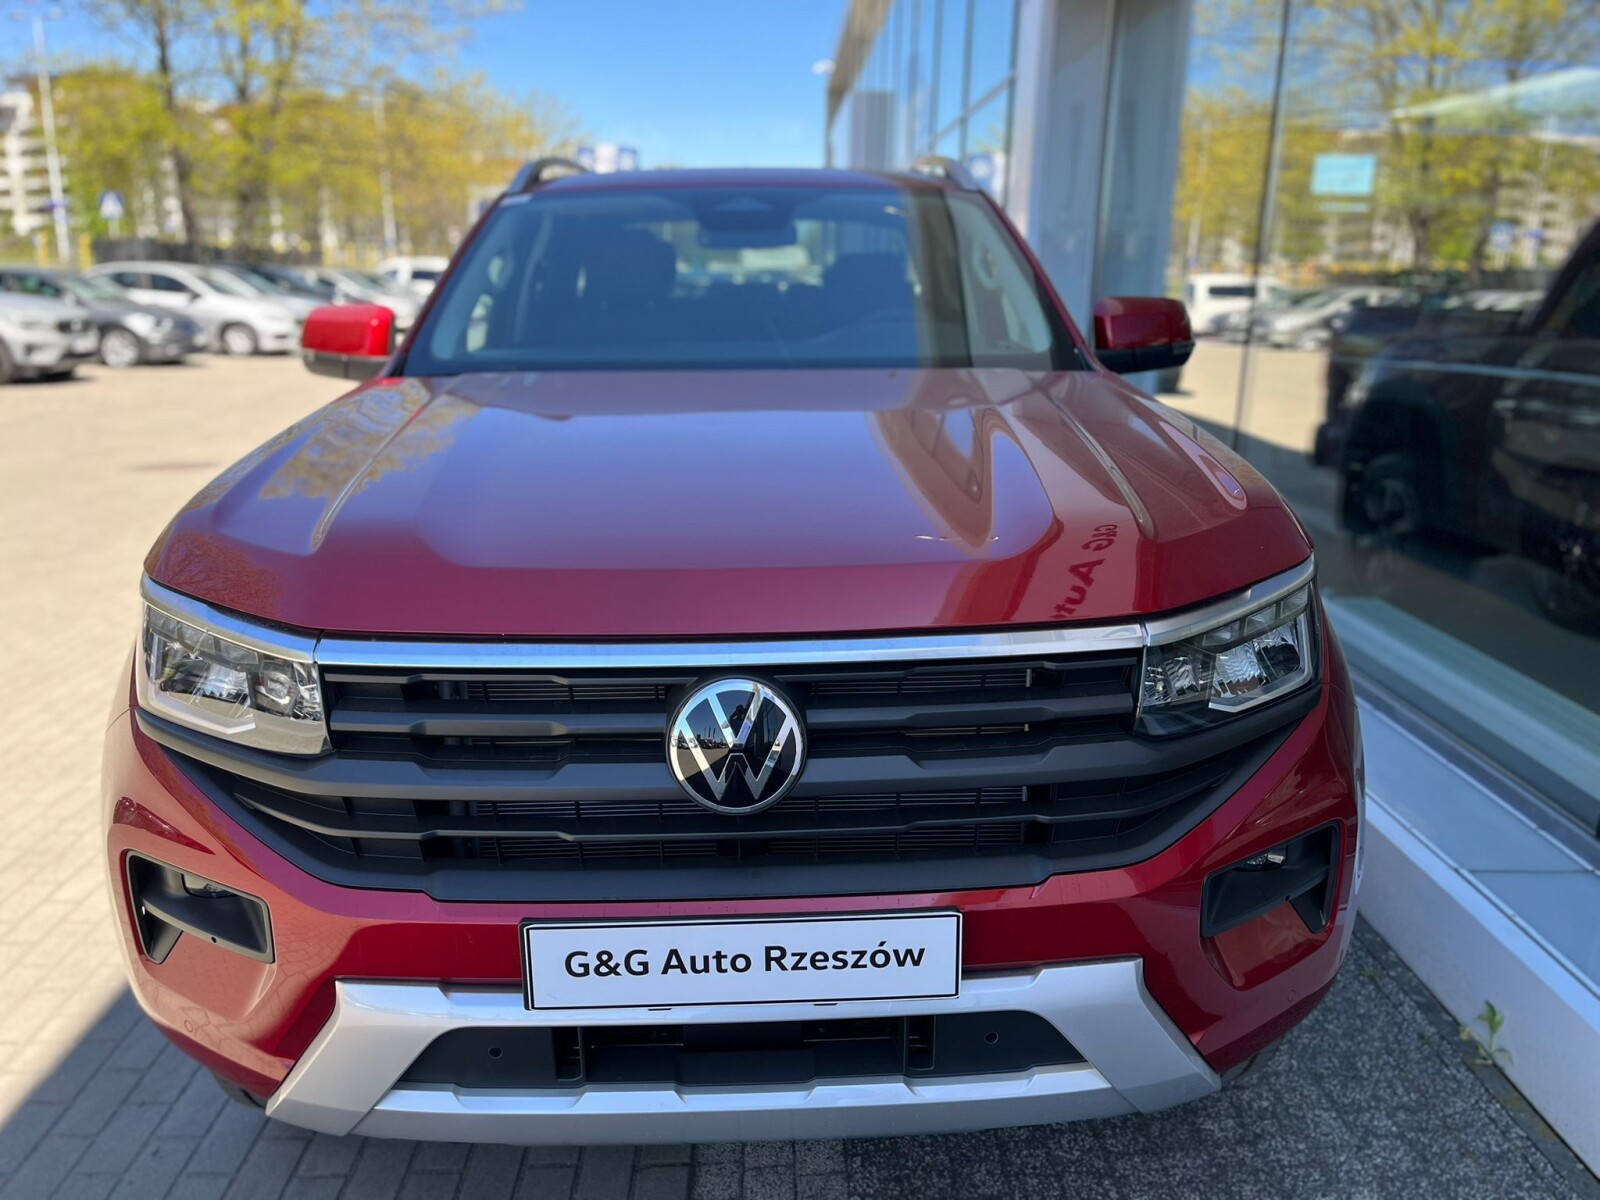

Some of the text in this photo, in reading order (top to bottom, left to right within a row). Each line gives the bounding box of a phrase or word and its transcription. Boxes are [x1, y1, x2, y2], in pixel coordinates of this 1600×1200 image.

[672, 682, 802, 808] VW
[564, 940, 926, 978] G&G Auto Rzeszów
